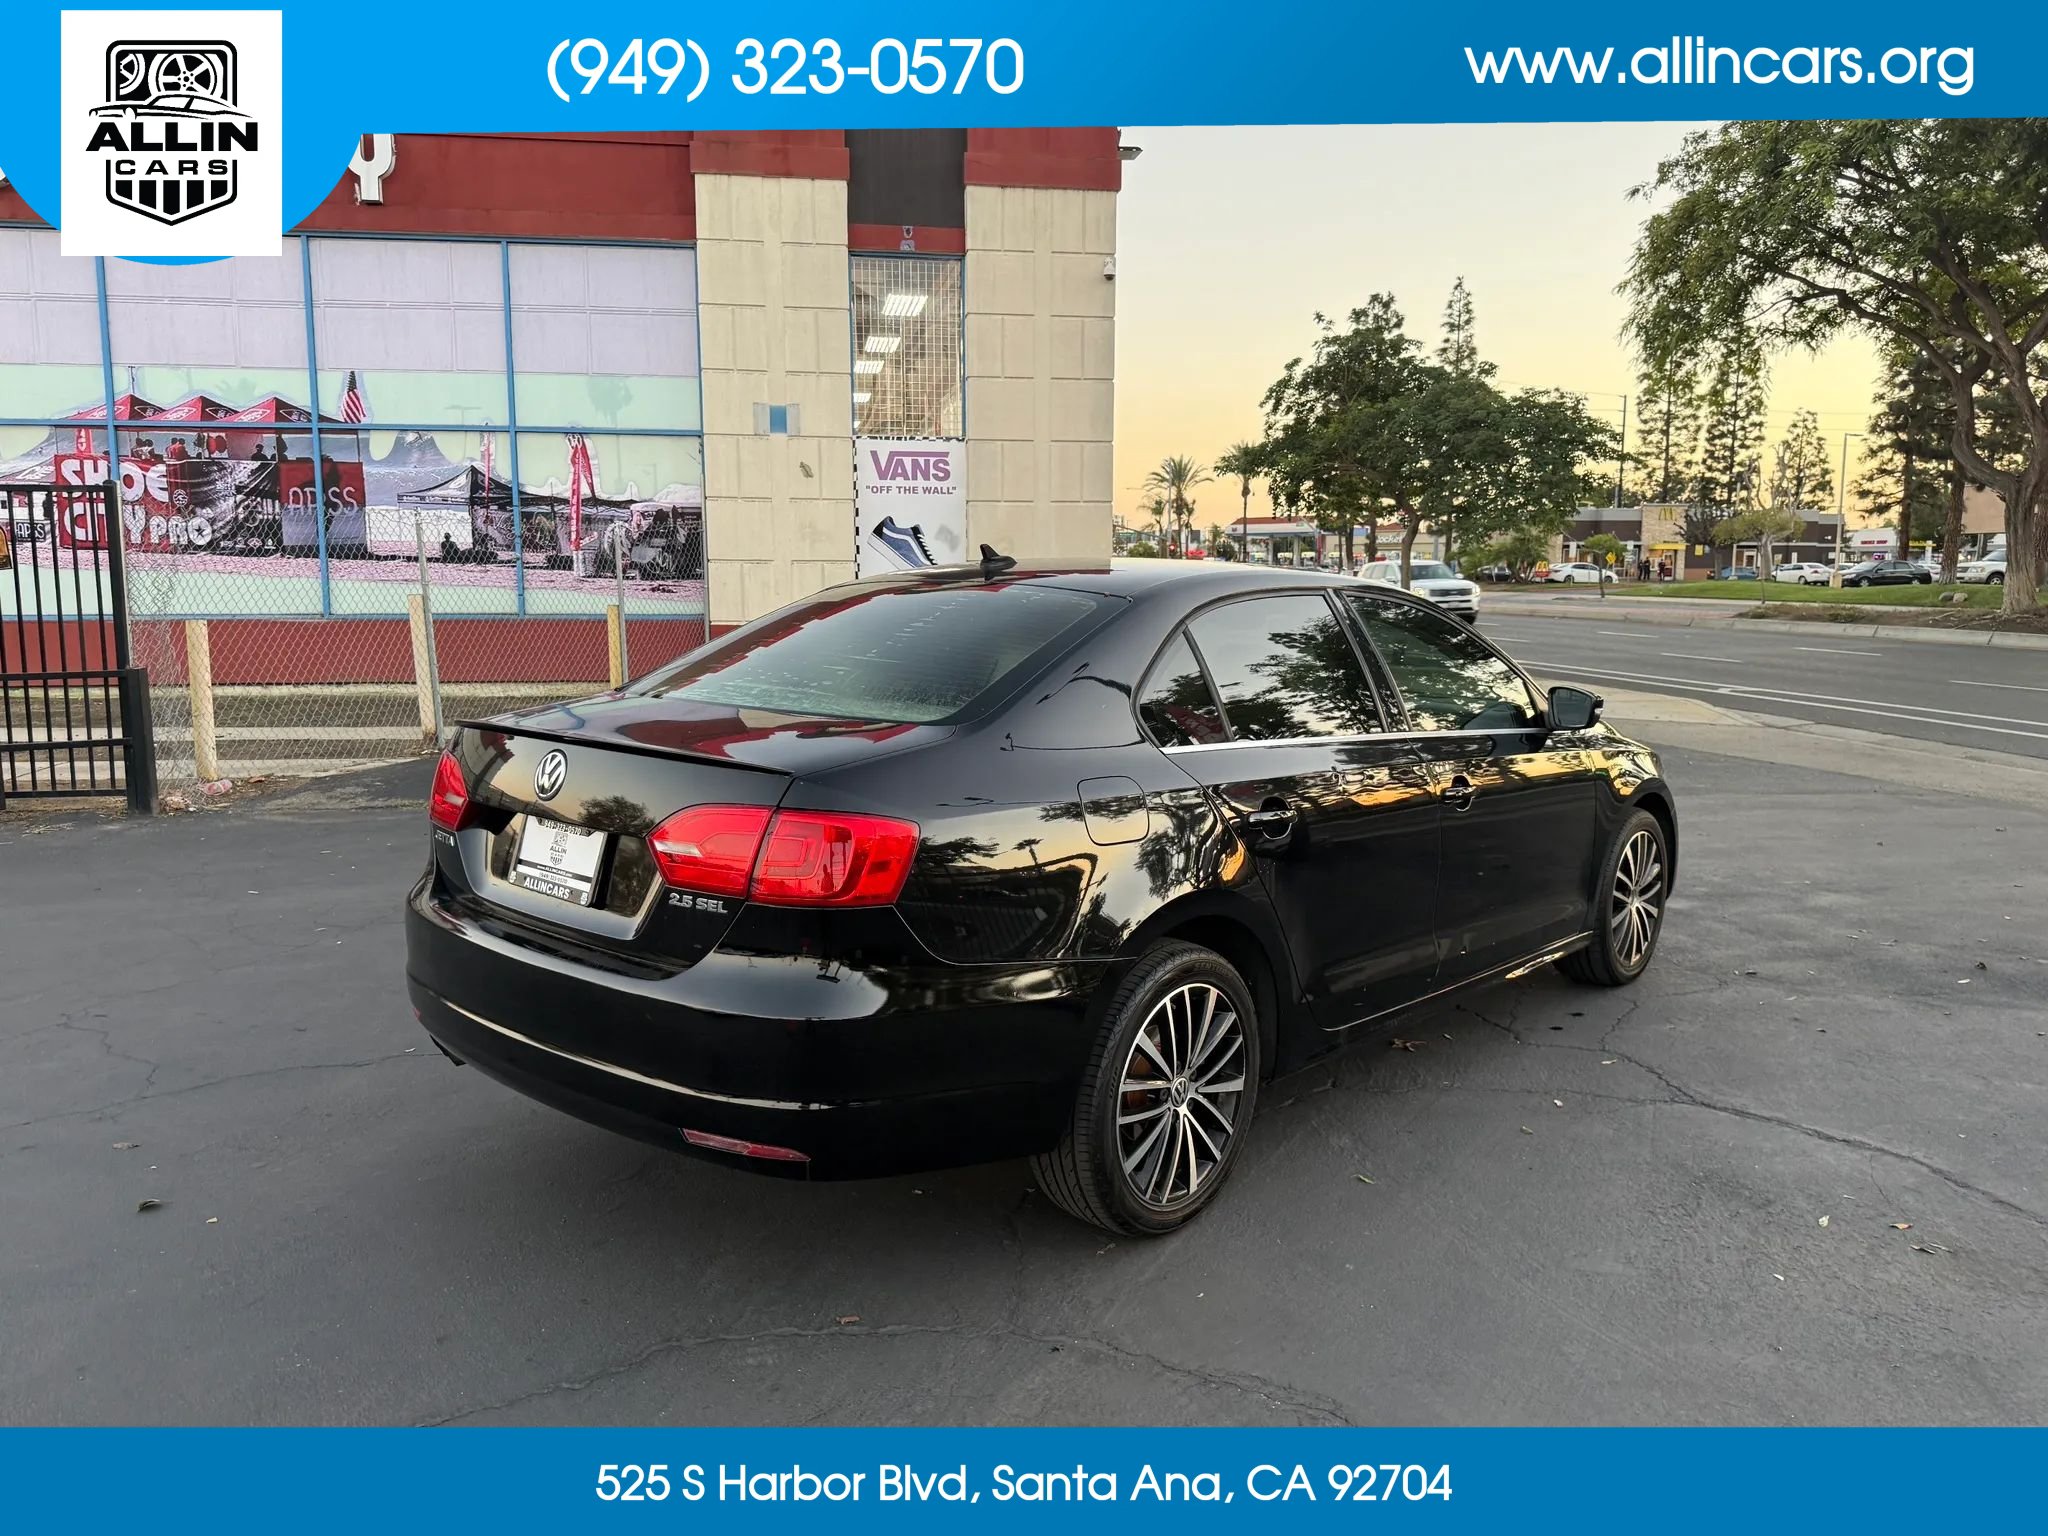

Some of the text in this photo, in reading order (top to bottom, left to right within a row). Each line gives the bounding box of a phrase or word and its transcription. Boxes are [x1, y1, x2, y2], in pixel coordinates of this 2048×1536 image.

[870, 450, 951, 482] VANS
[61, 459, 169, 503] SHOE
[865, 485, 957, 495] "OFF THE WALL"
[434, 829, 456, 847] JETTA
[524, 877, 570, 899] ALLINCARS
[695, 897, 728, 914] SEL
